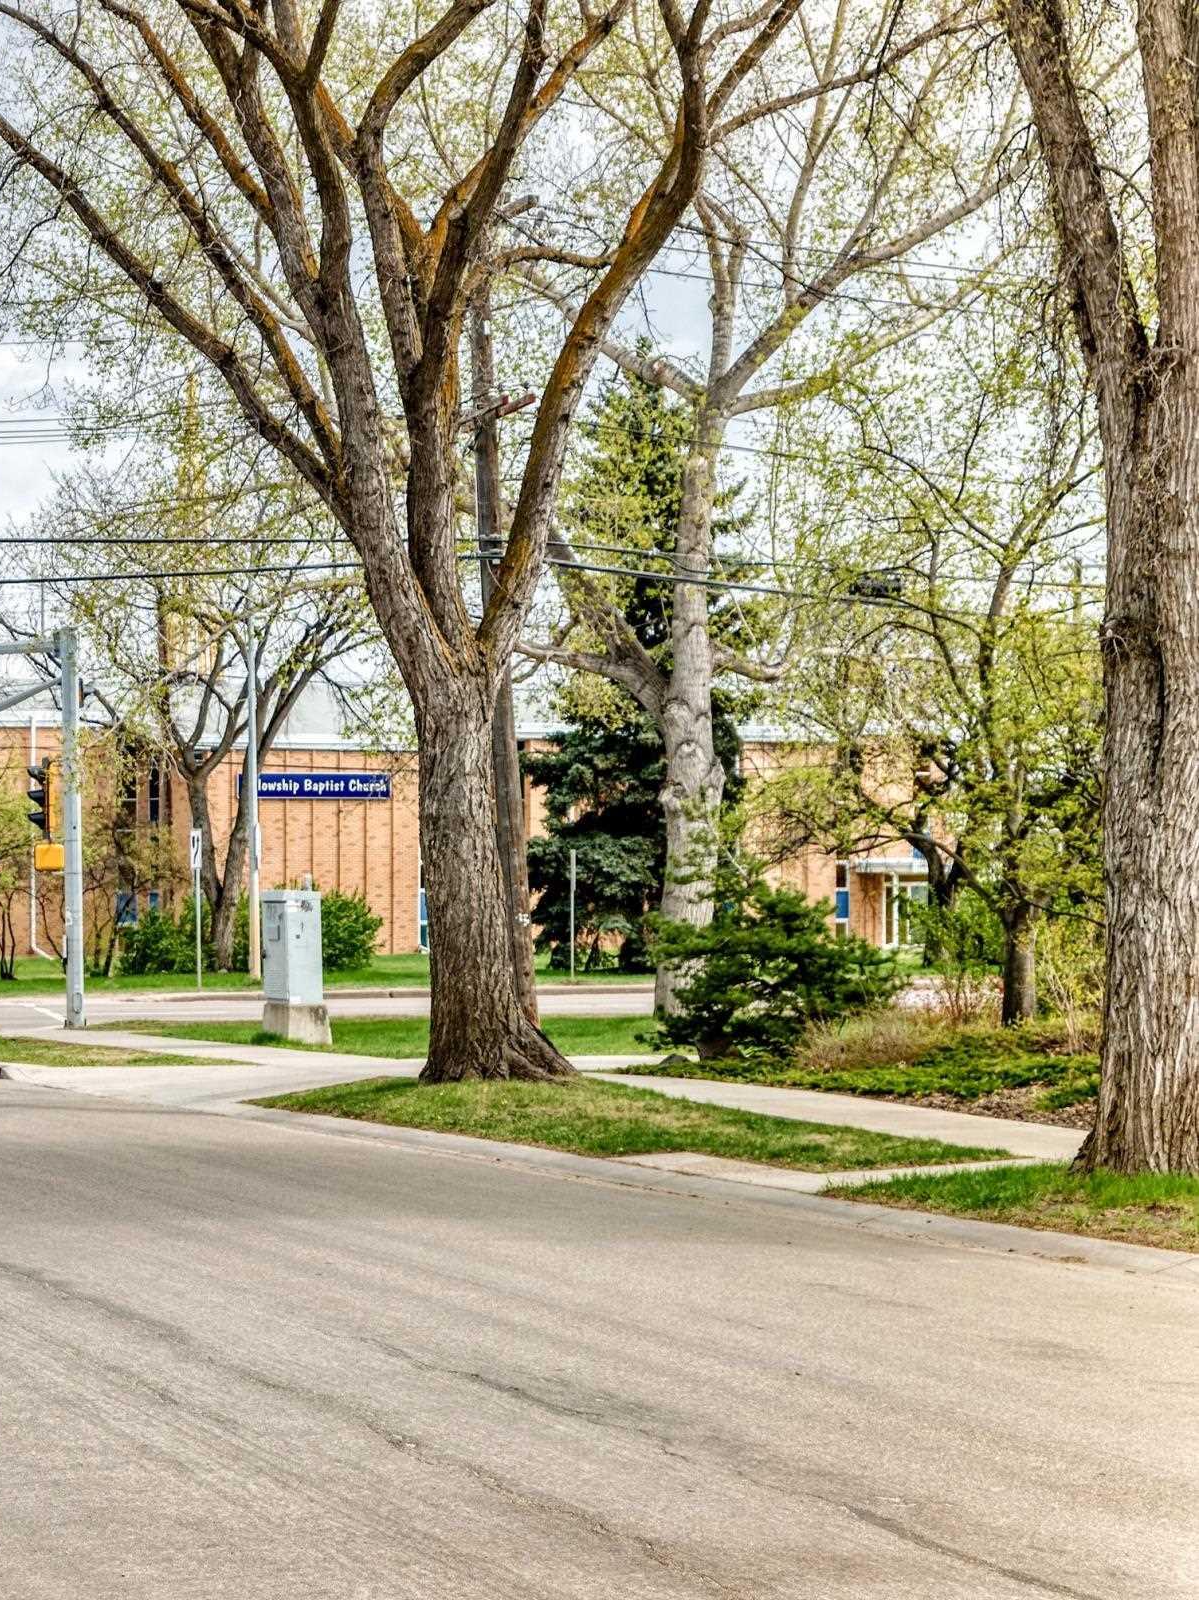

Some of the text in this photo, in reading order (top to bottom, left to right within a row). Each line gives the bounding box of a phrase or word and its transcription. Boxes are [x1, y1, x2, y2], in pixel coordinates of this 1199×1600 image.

[258, 778, 387, 795] lowship Baptist Church
